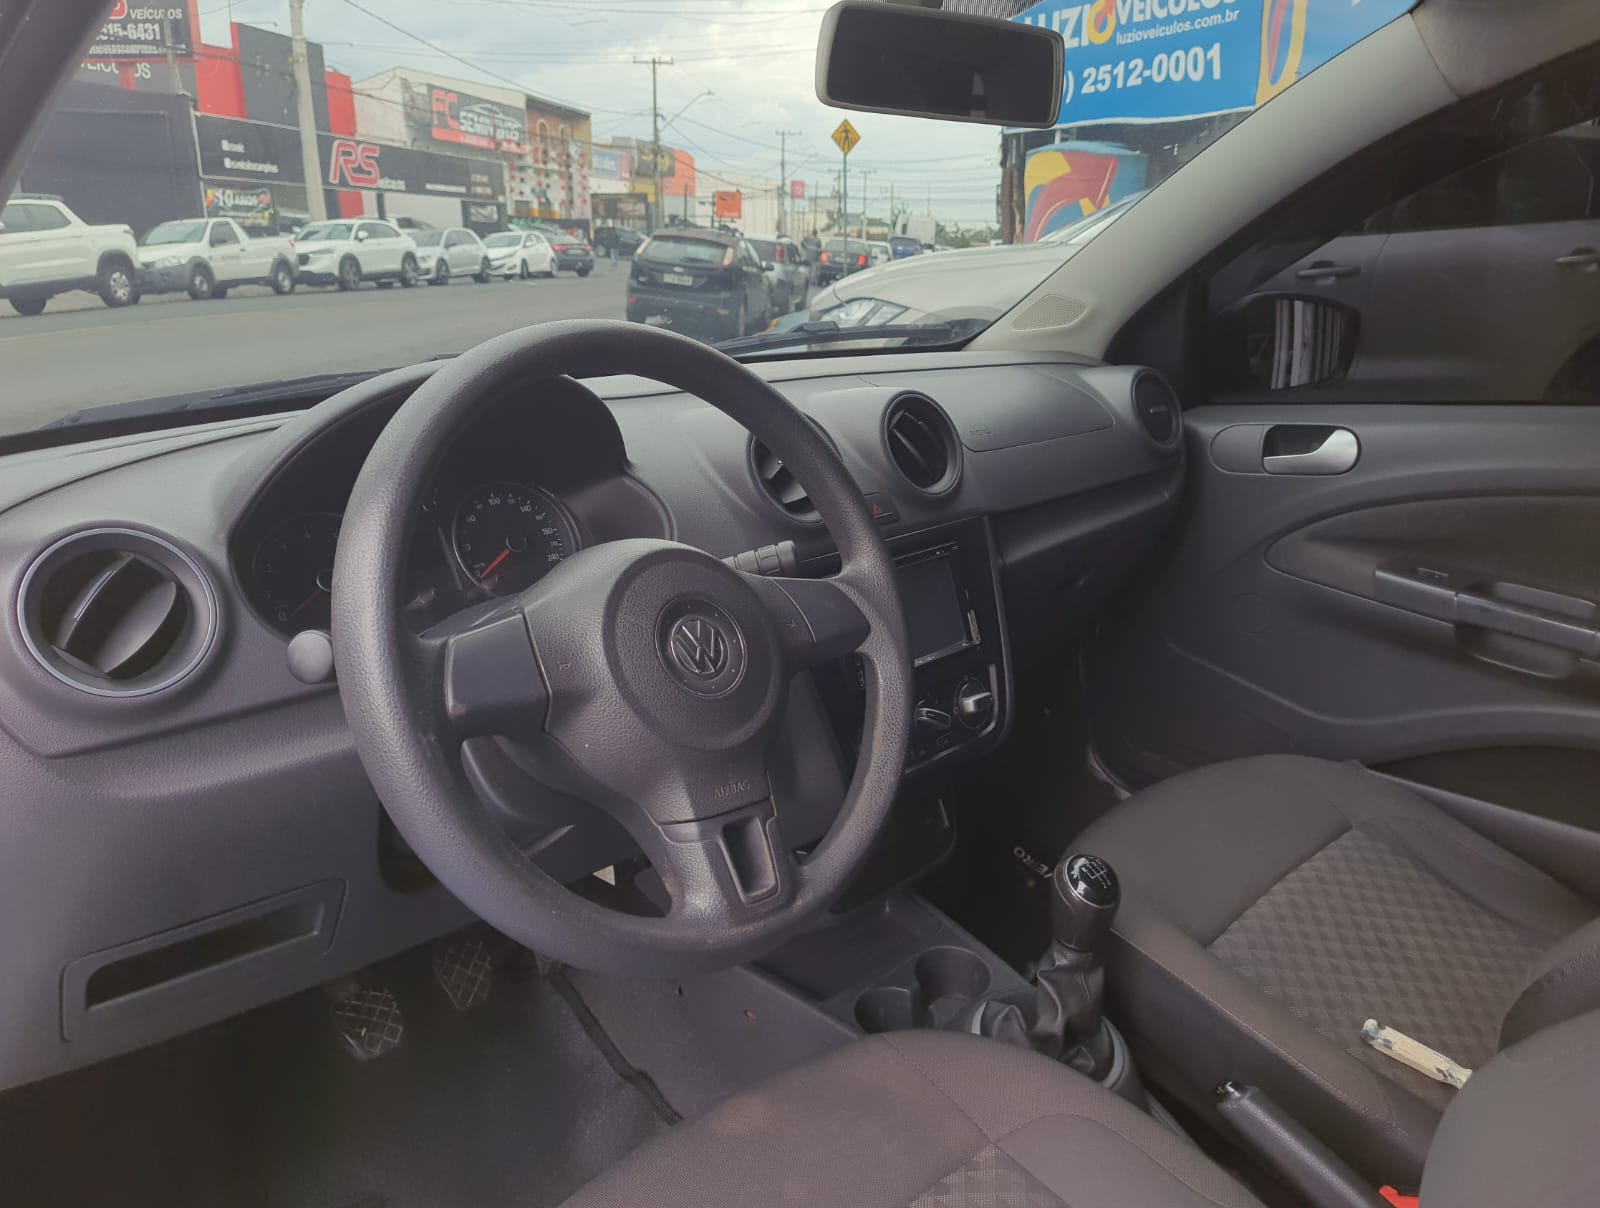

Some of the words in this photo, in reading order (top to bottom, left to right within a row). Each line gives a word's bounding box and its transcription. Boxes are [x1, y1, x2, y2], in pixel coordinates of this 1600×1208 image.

[96, 23, 161, 40] 15-6431
[1024, 1, 1117, 50] ZIO
[1116, 0, 1235, 26] VEIC
[1116, 9, 1240, 45] luzioveiculos.com.br
[1081, 42, 1221, 95] 2512-0001
[432, 89, 459, 130] FC
[329, 140, 380, 188] RS
